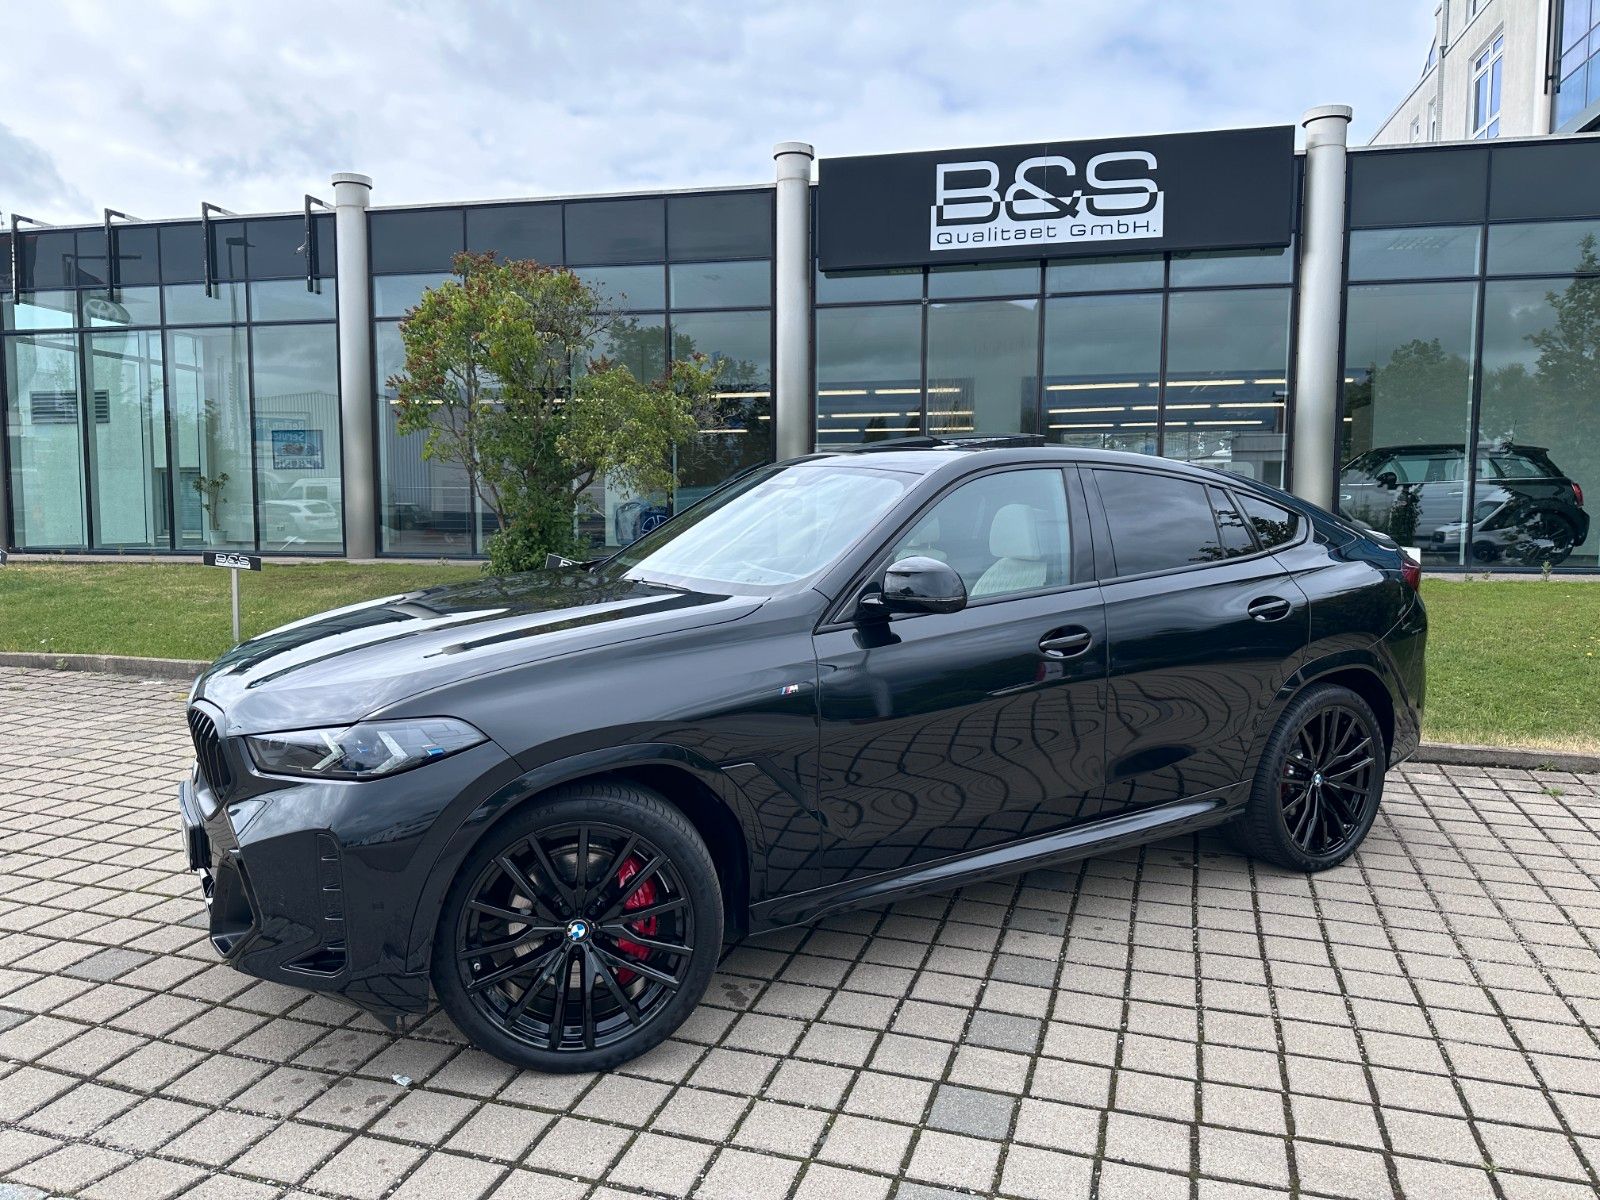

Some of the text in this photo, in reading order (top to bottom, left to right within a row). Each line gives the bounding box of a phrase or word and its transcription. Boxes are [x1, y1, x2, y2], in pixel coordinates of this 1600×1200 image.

[936, 151, 1158, 227] B&S
[936, 220, 1157, 245] Qualitaet GmbH.
[215, 554, 250, 566] B&S
